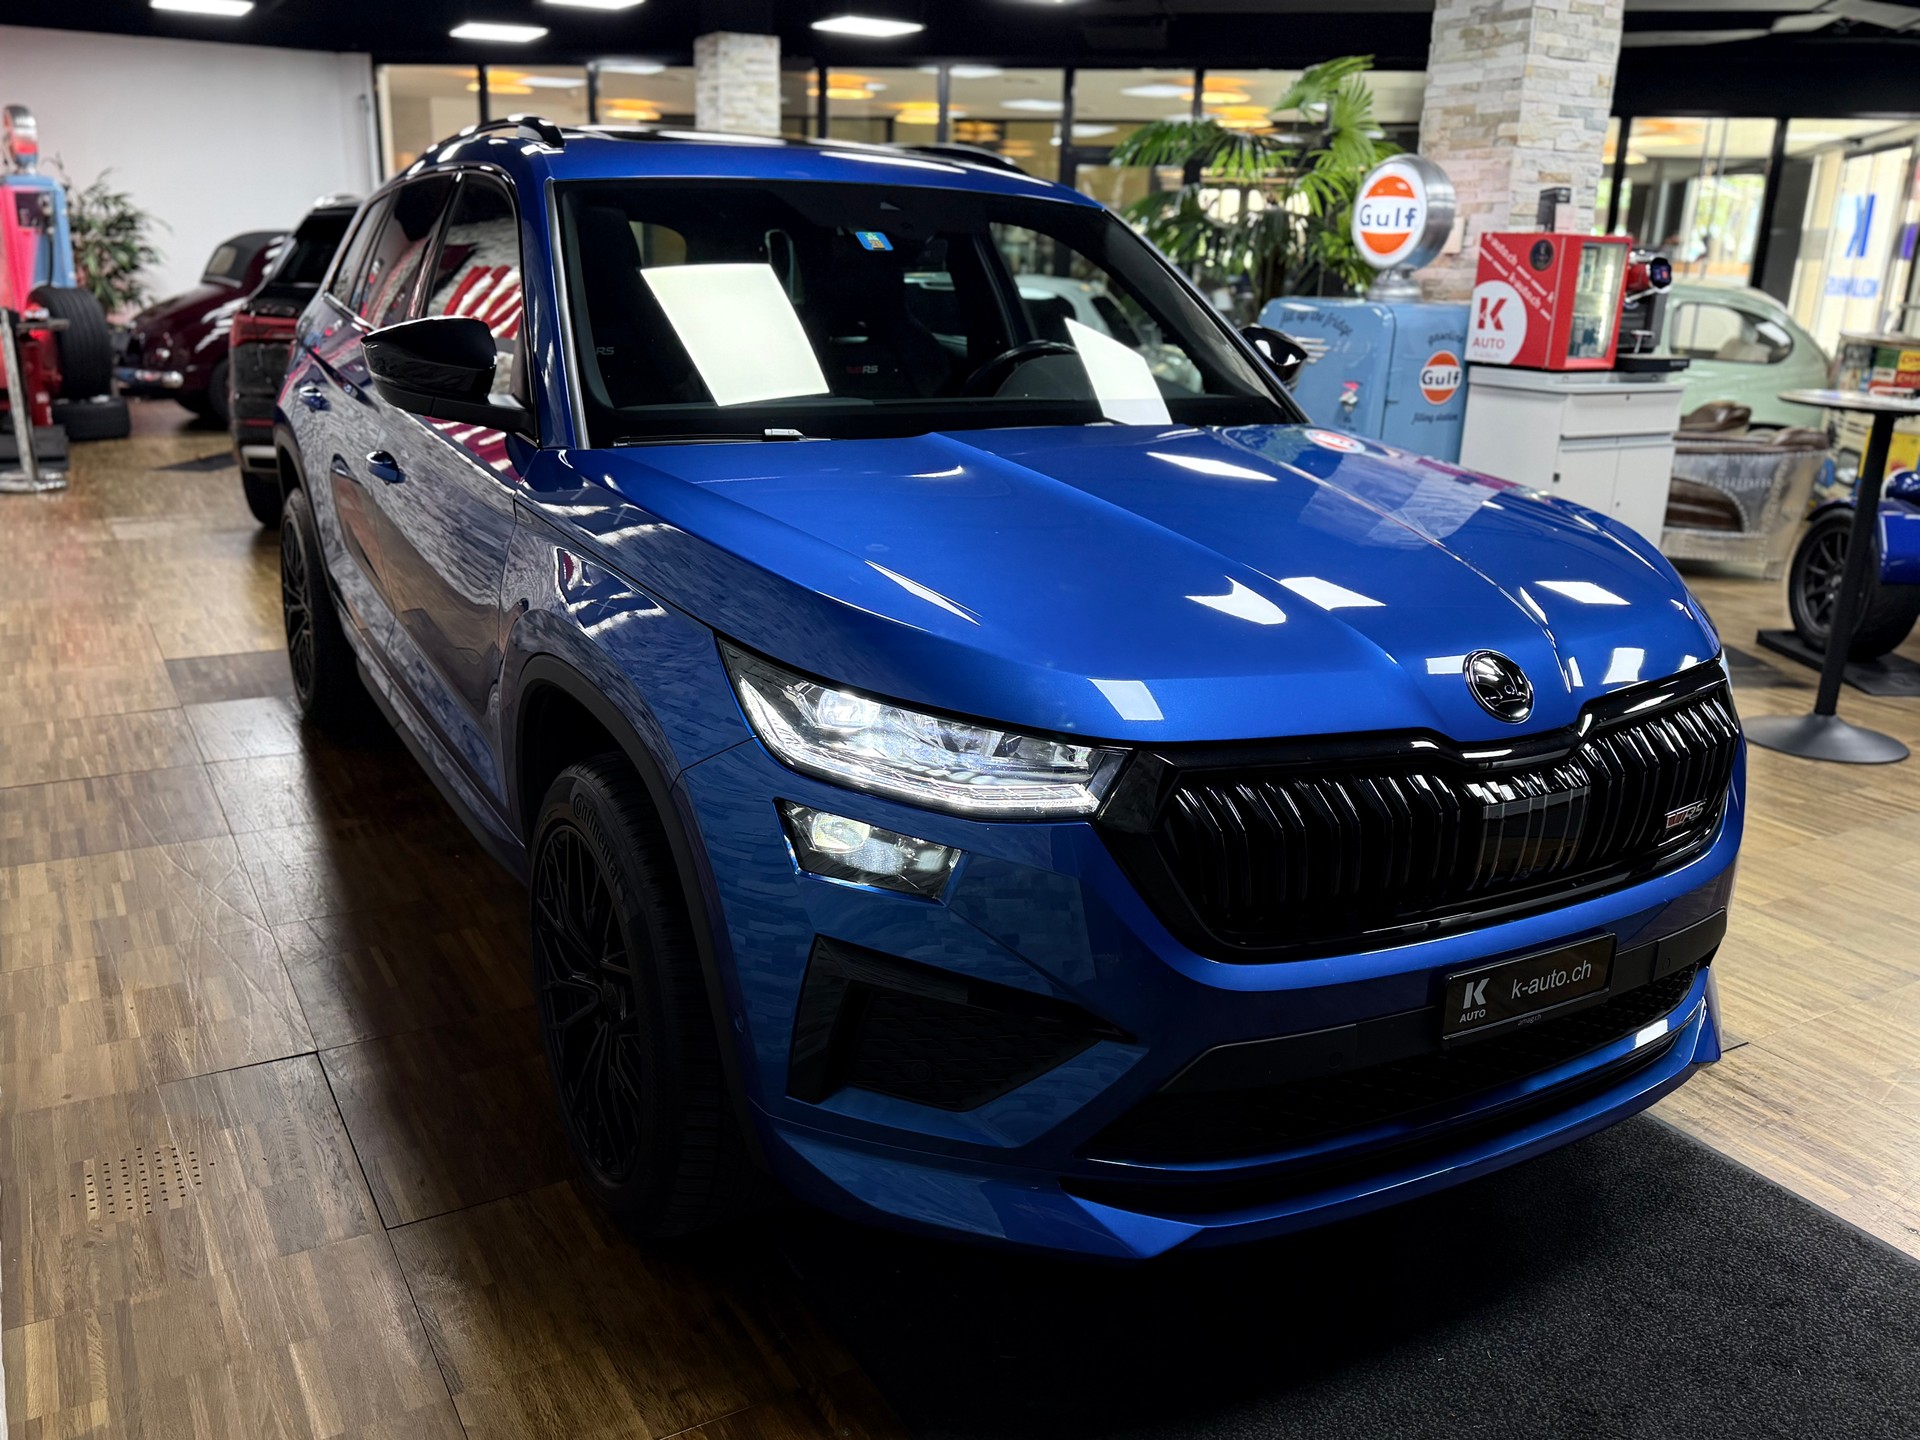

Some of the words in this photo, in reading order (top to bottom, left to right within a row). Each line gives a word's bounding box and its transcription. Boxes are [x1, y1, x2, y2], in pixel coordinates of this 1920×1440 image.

[1359, 203, 1417, 228] Gulf
[1477, 296, 1507, 331] K
[1472, 337, 1506, 349] AUTO
[1421, 369, 1460, 385] Gulf
[573, 793, 621, 888] Continental
[1462, 977, 1490, 1009] K
[1511, 959, 1592, 999] k-auto.ch
[1459, 1008, 1487, 1023] AUTO
